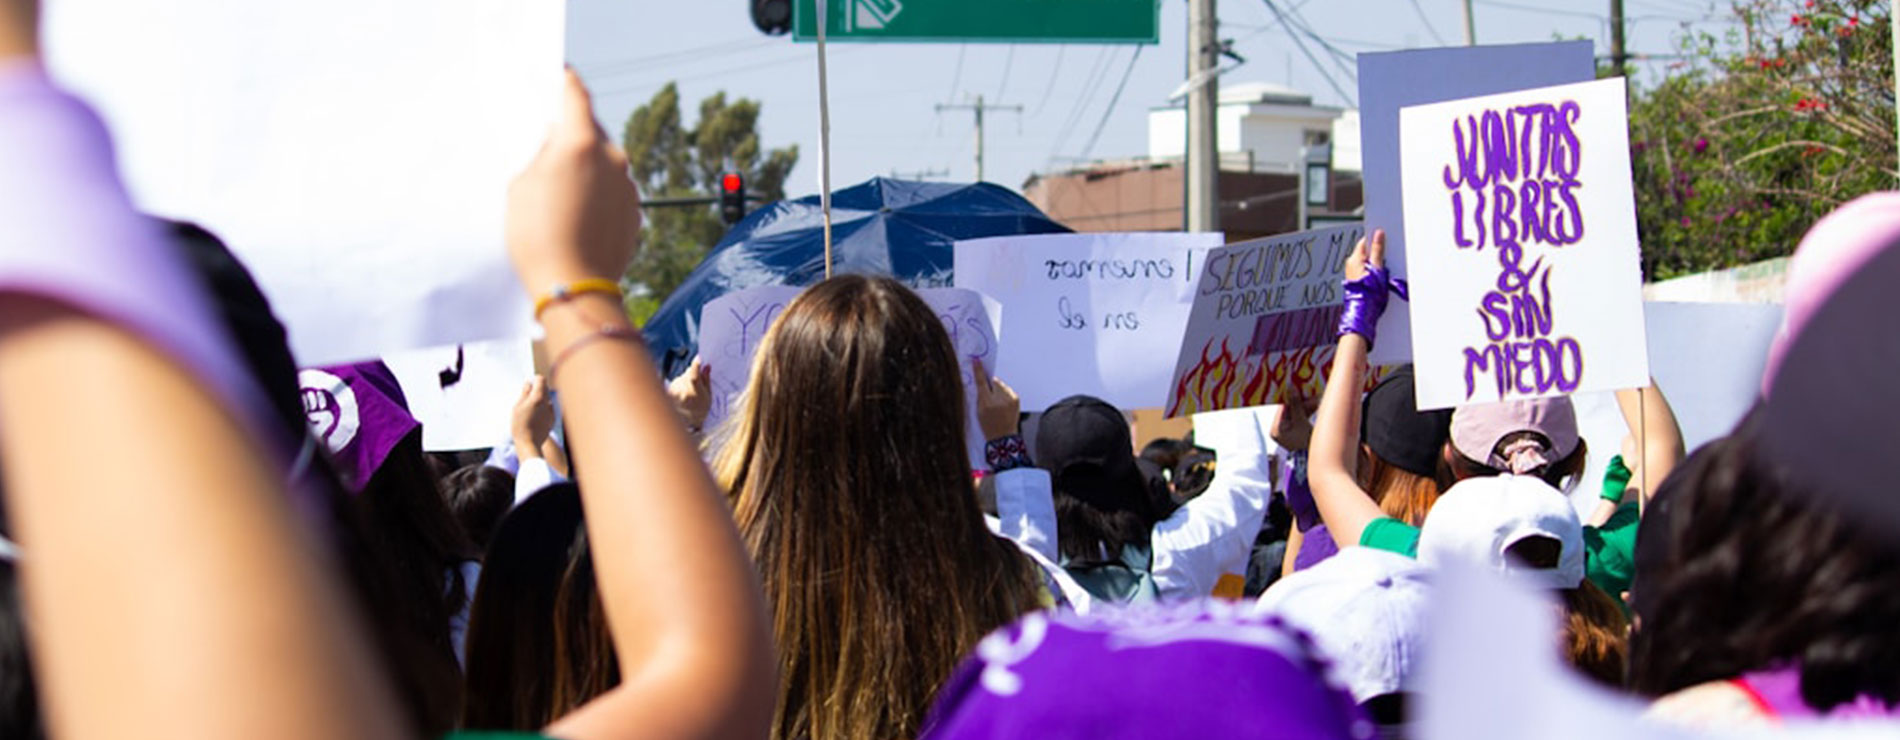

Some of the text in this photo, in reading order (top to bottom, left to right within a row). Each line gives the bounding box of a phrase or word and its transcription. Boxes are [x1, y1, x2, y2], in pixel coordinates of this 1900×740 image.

[1443, 100, 1582, 190] JUNTAS
[1452, 179, 1584, 250] LIBRES
[1203, 236, 1315, 295] SEGUIMOS
[1498, 240, 1544, 293] &
[1217, 280, 1336, 319] PORQUE NOS
[1477, 265, 1553, 342] SIN
[1462, 337, 1583, 401] MIEDO
